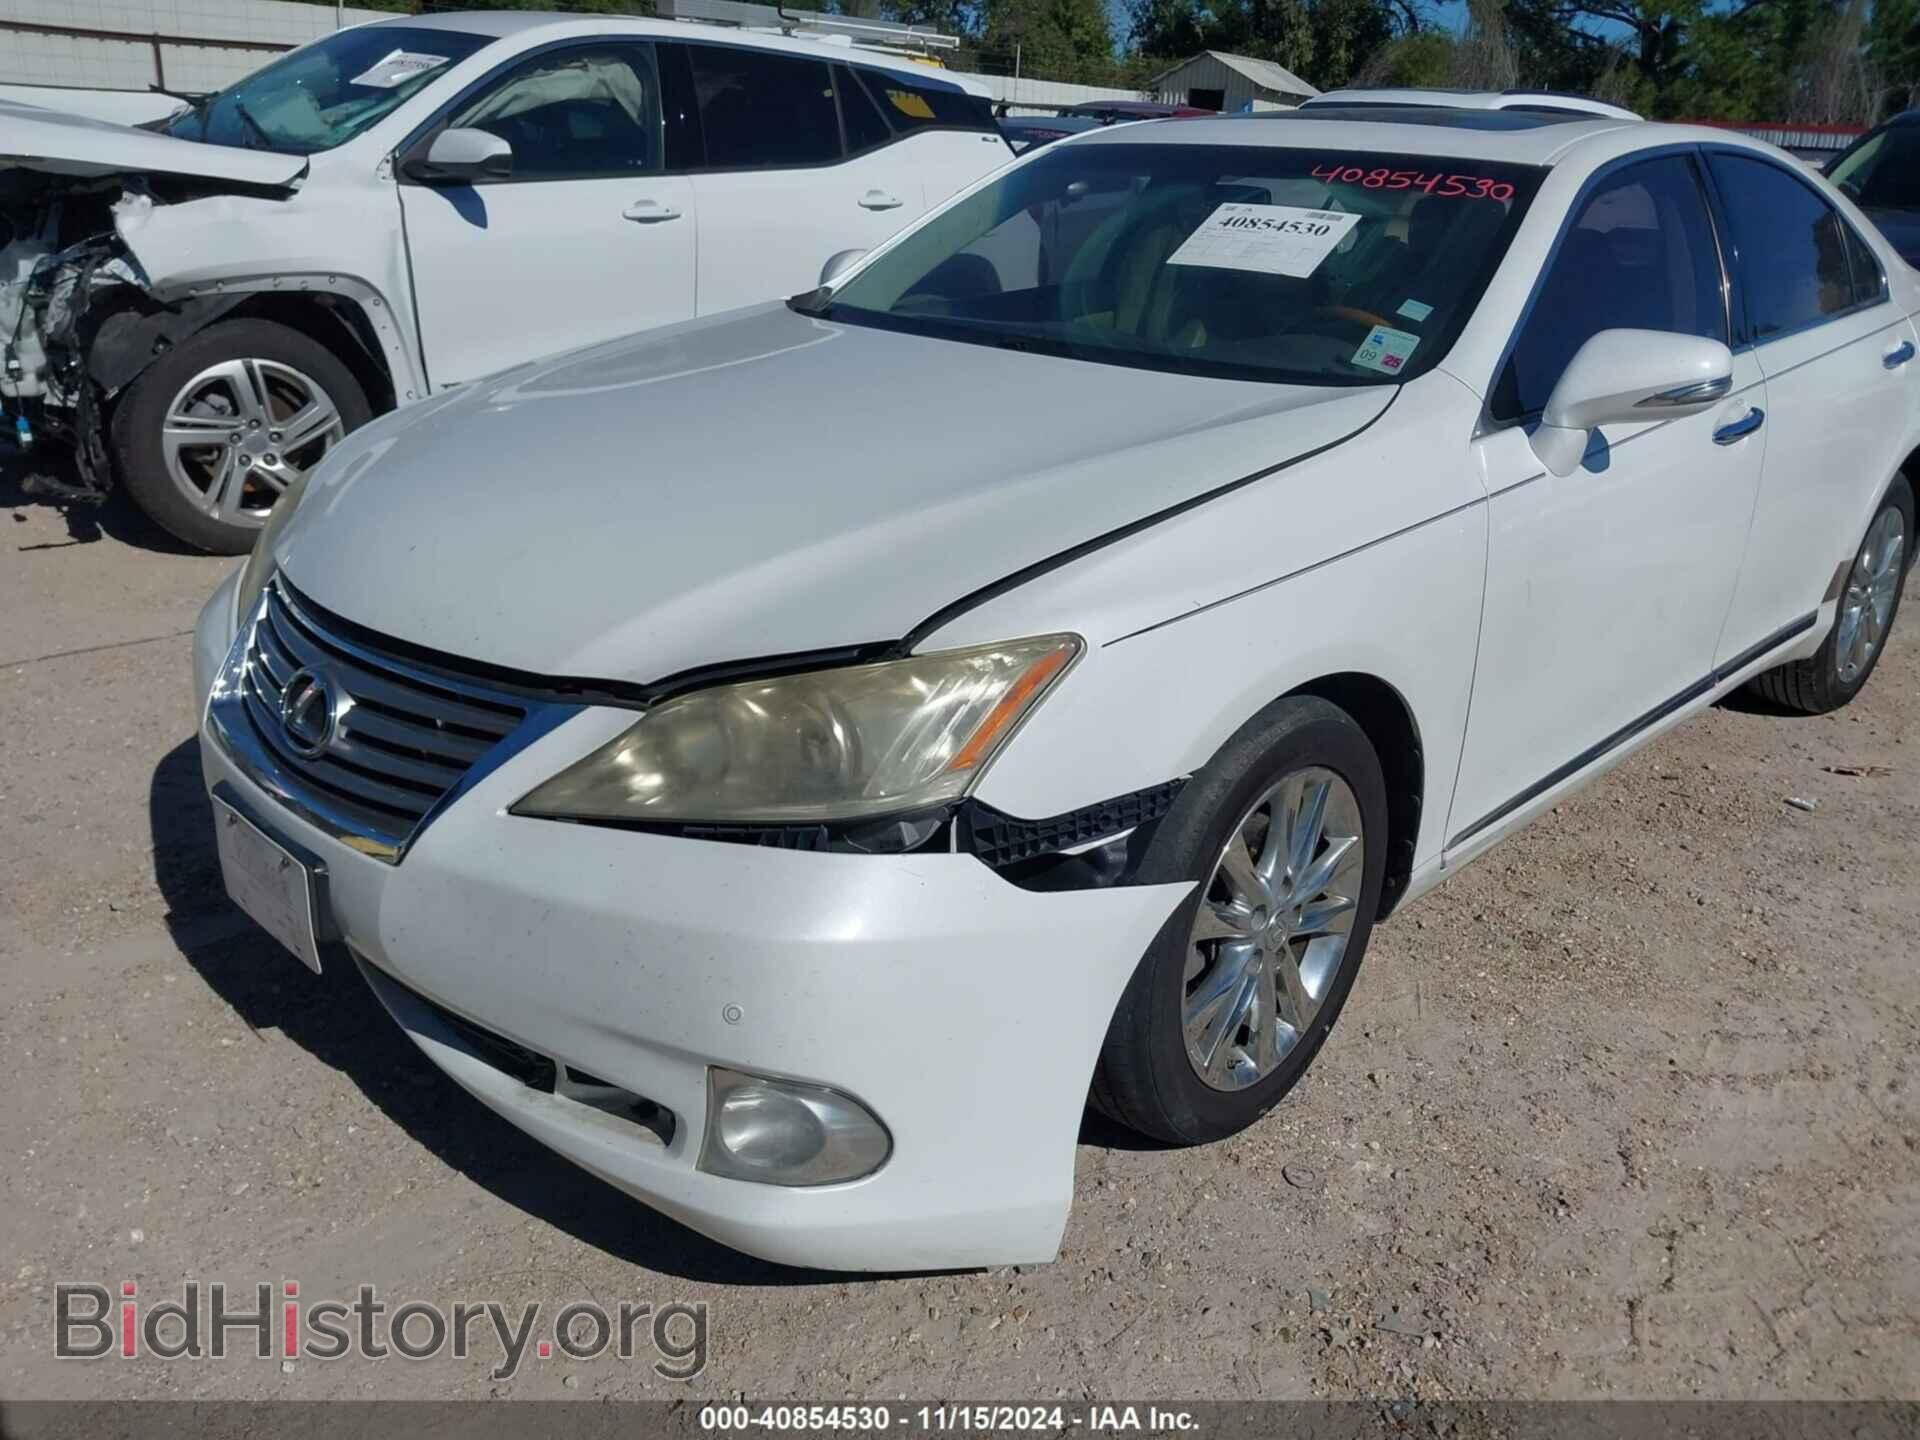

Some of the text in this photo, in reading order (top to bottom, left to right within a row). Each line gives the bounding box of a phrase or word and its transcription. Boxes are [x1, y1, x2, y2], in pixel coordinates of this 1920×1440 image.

[1311, 164, 1515, 201] 40854530
[1219, 215, 1331, 237] 40854530
[1359, 349, 1377, 361] 09
